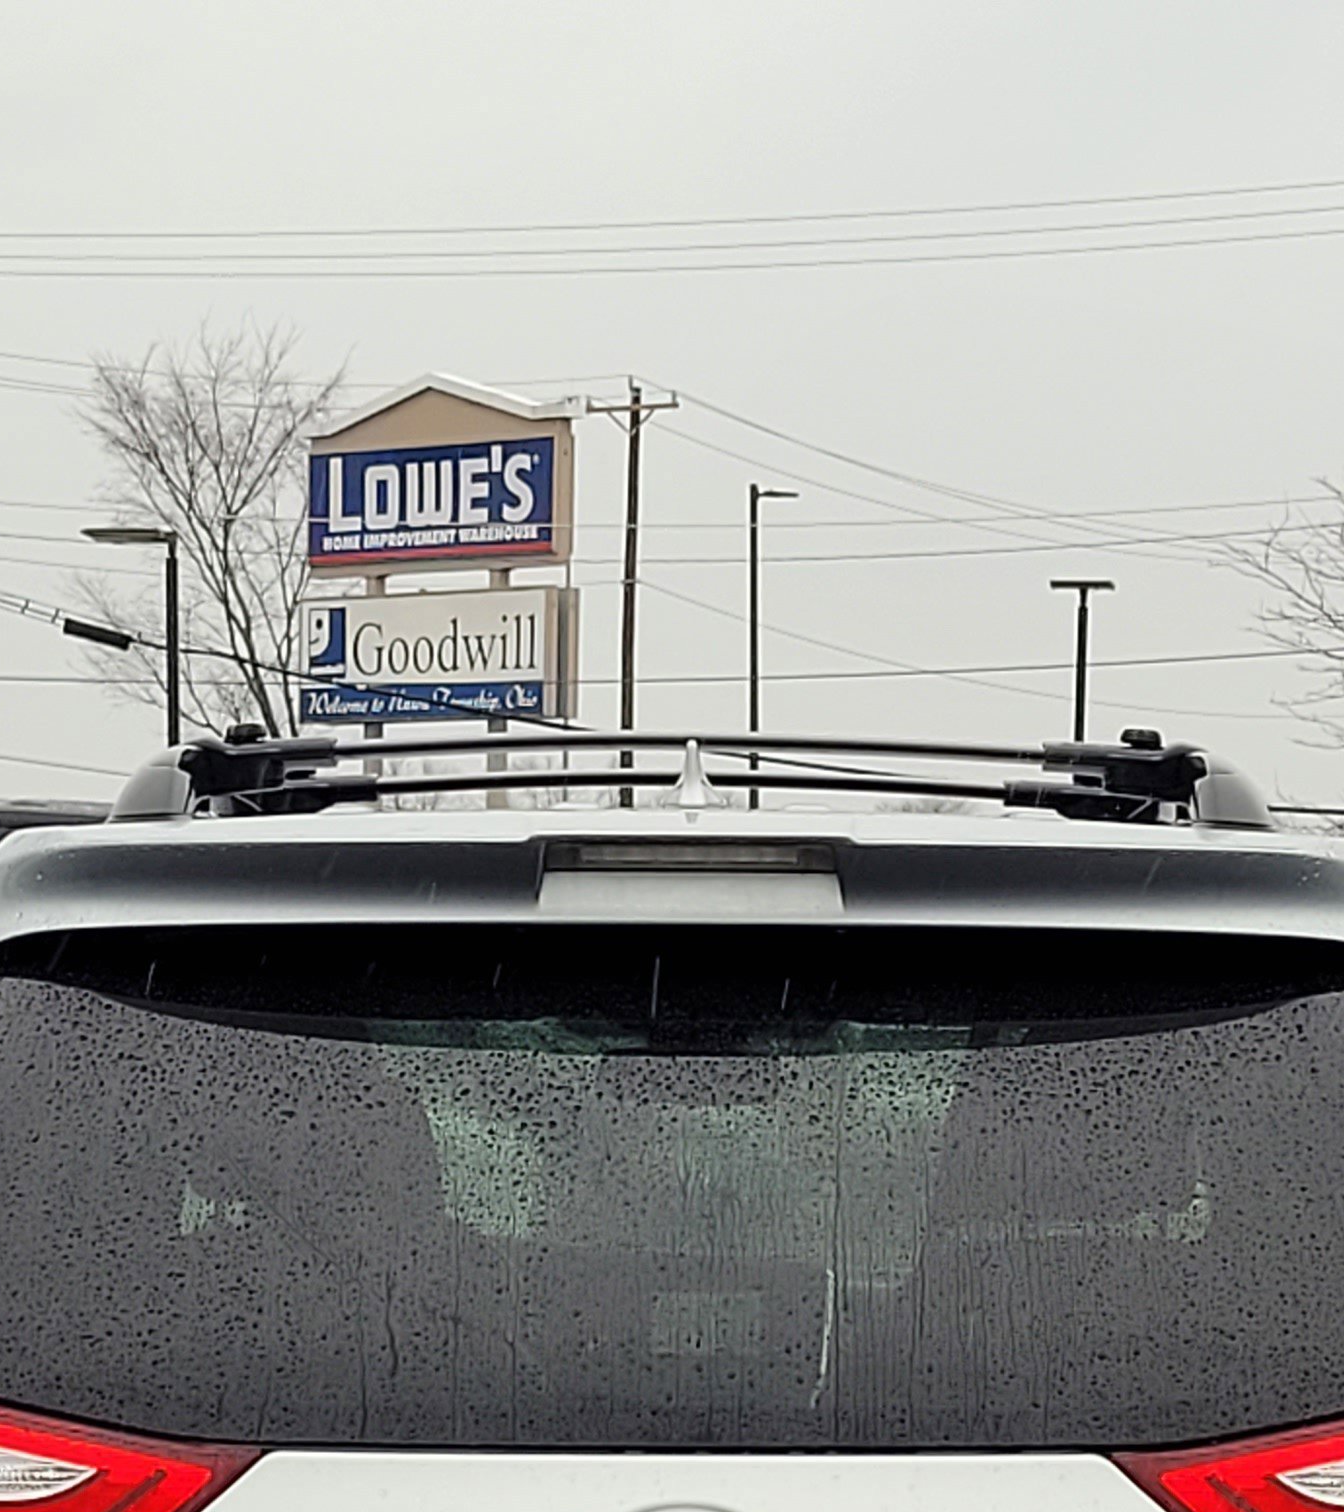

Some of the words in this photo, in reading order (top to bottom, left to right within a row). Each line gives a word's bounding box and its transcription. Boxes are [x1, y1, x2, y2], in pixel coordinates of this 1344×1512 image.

[328, 444, 535, 533] LOWE'S
[323, 536, 361, 551] HOME
[363, 528, 457, 549] IMPROVEMENT
[458, 523, 539, 544] WAREHOUSE
[353, 614, 537, 675] Goodwill
